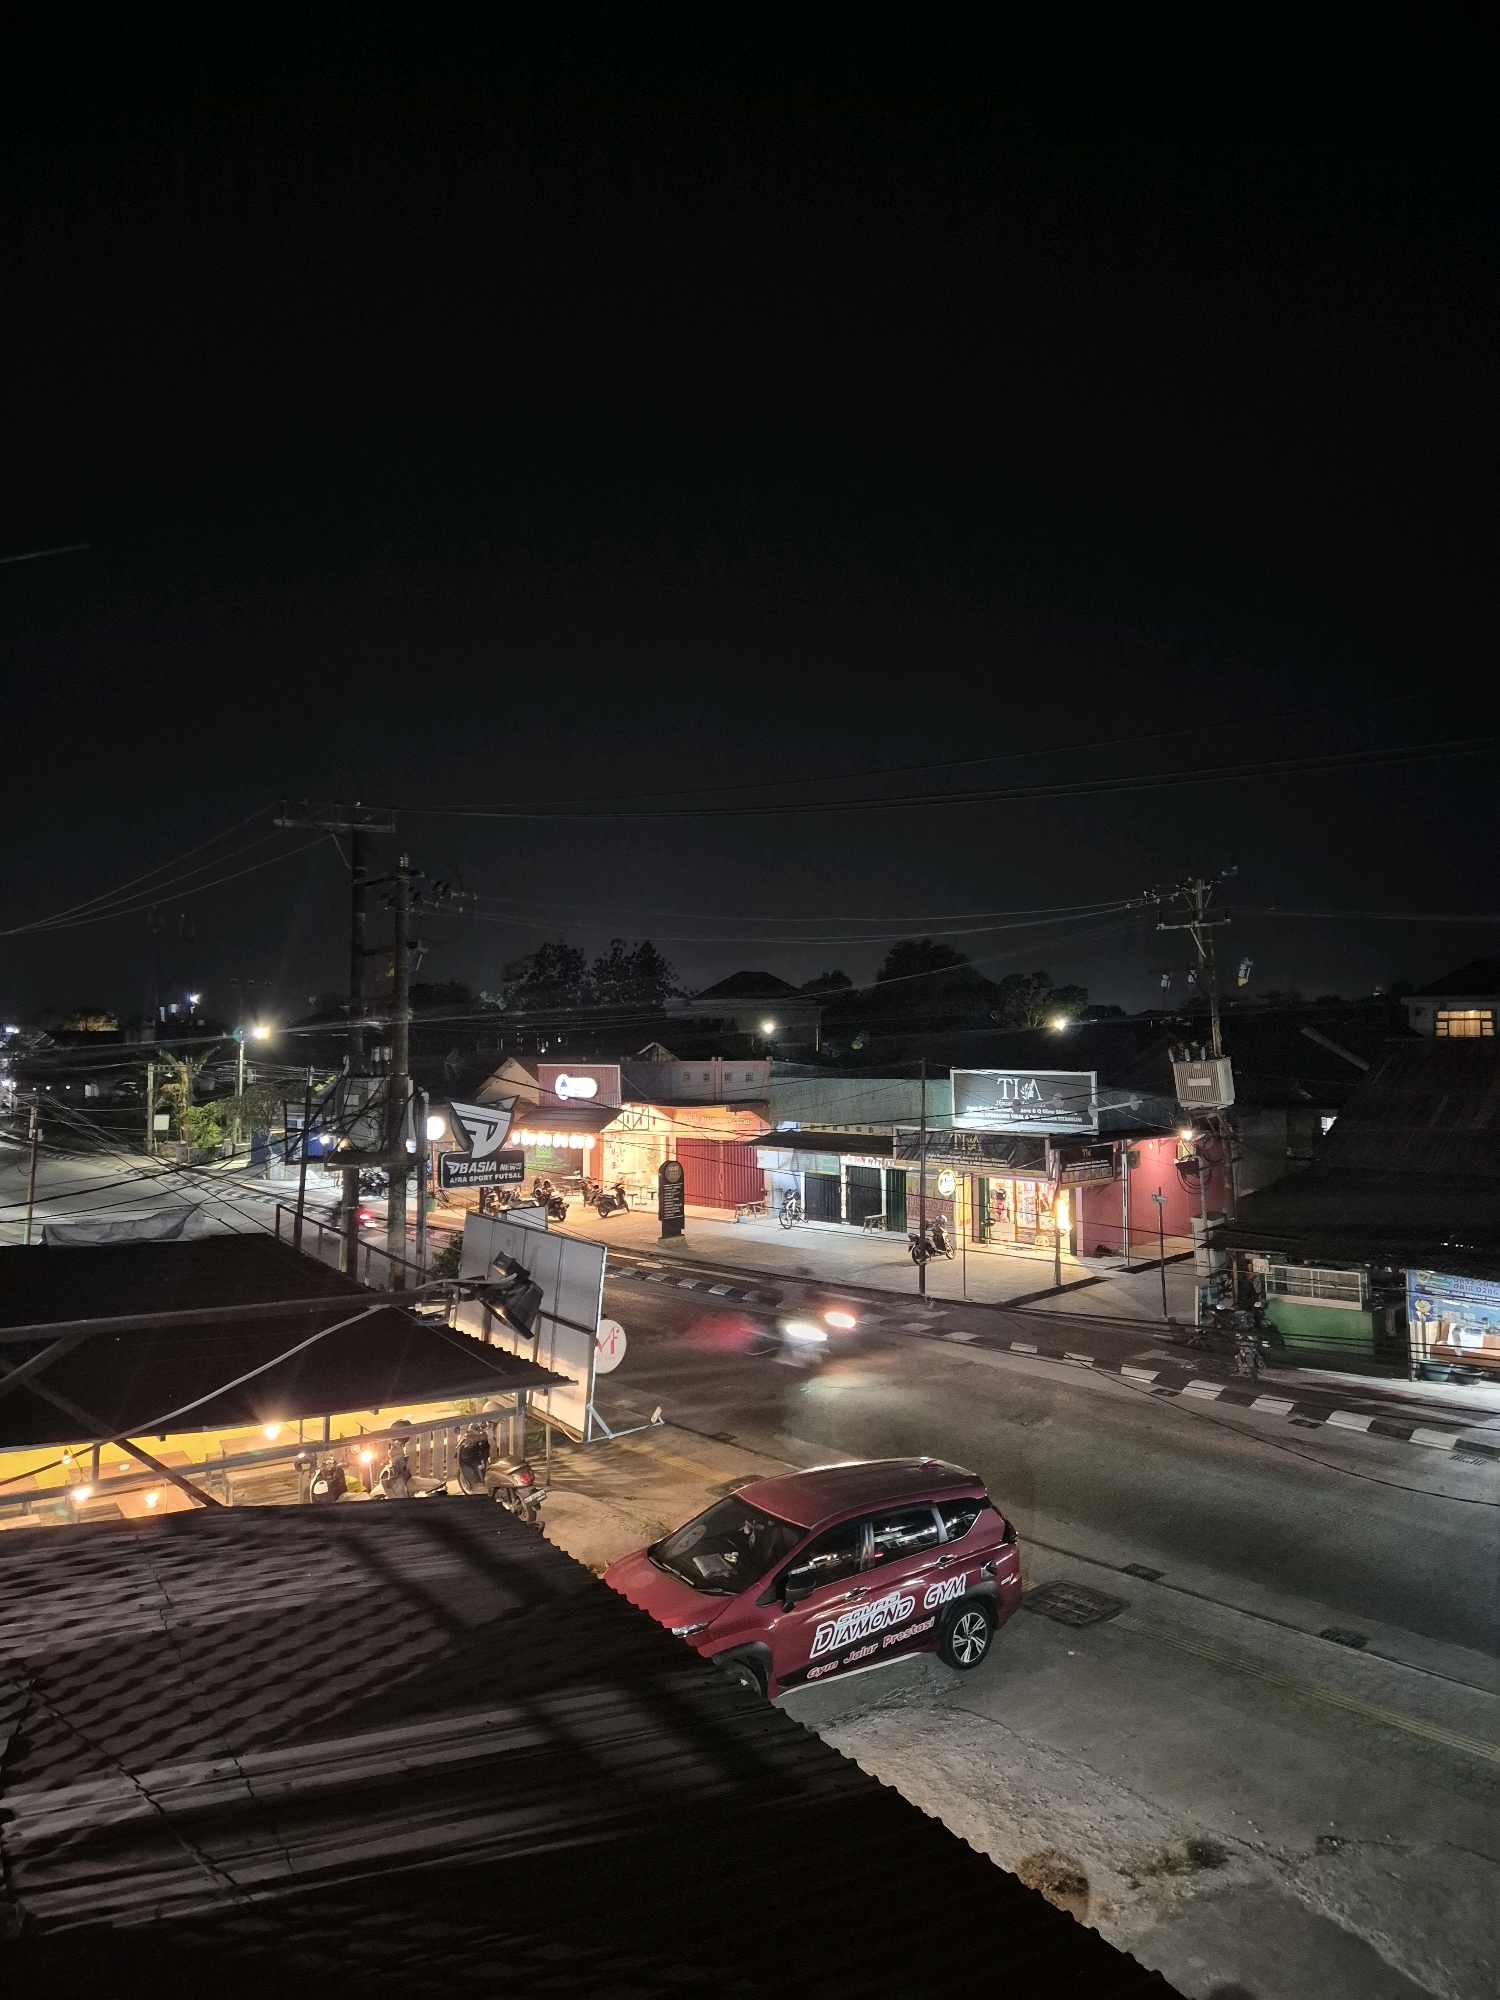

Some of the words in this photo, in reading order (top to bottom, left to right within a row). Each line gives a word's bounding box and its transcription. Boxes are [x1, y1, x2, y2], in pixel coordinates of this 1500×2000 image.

[469, 1174, 493, 1182] SPORT
[495, 1172, 522, 1180] FUTSAL
[500, 1162, 522, 1172] NEWS
[1453, 1284, 1473, 1292] 0818
[1476, 1286, 1499, 1296] 0286
[810, 1596, 915, 1659] DIAMOND
[924, 1573, 966, 1609] GYM
[838, 1591, 900, 1625] SQUAD
[807, 1660, 838, 1679] Gym
[843, 1643, 879, 1664] Jalur
[883, 1616, 935, 1648] Prestasi
